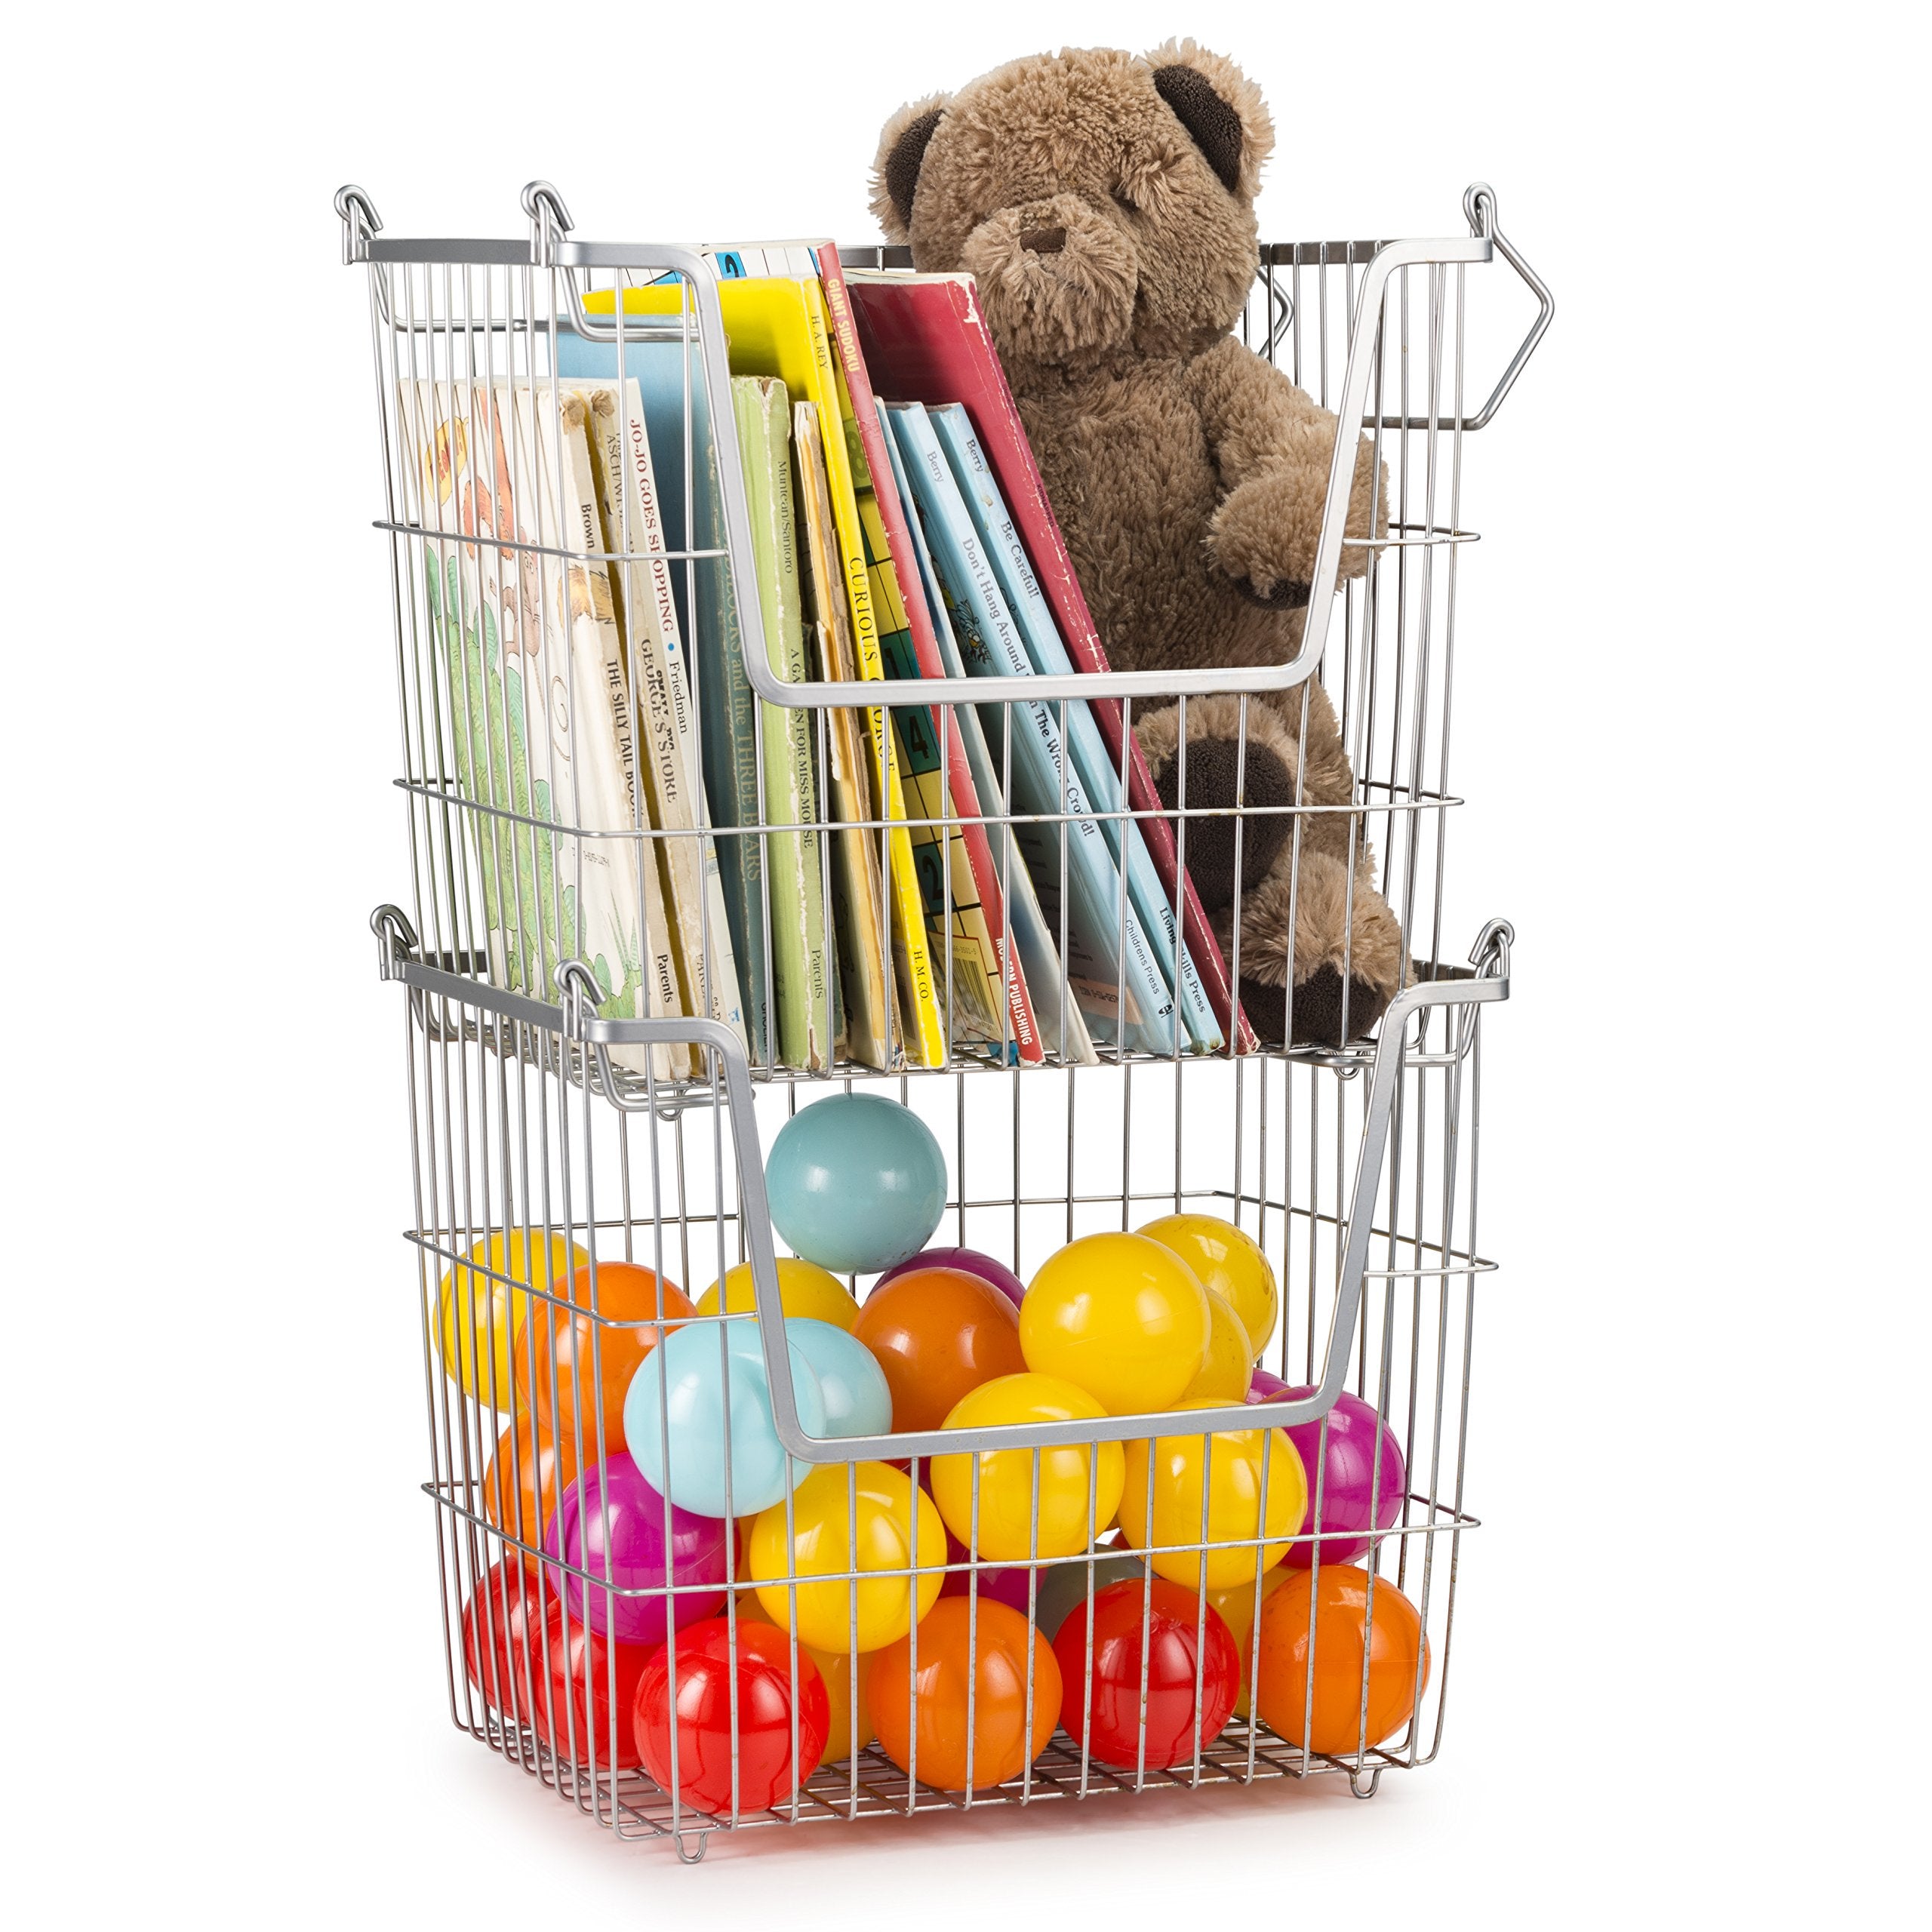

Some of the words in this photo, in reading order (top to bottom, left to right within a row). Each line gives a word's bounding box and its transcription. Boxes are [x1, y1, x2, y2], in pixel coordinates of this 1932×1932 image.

[811, 315, 820, 329] H.
[814, 331, 822, 343] A.
[828, 278, 847, 317] GIANT
[838, 321, 860, 372] SUDOKU
[817, 346, 829, 371] REY
[630, 419, 647, 472] JO-JO
[639, 478, 657, 529] GOES
[927, 451, 944, 482] Berry
[966, 438, 984, 472] Berry
[582, 503, 595, 549] Brown
[778, 460, 793, 574] Muntean/Santoro
[1036, 482, 1055, 528] KIDNAPPED
[1001, 520, 1014, 542] Be
[1011, 544, 1040, 598] Careful!
[962, 537, 986, 579] Don't
[980, 580, 1001, 620] Hang
[996, 621, 1026, 673] Around
[607, 659, 622, 688] THE
[731, 659, 747, 691] and
[791, 648, 800, 659] A
[850, 557, 878, 662] CURIOUS
[869, 677, 895, 771] ORGE
[612, 693, 629, 729] SILLY
[669, 660, 688, 734] Friedman
[734, 695, 748, 726] the
[792, 663, 804, 724] GAEN
[620, 734, 633, 767] TAIL
[795, 727, 806, 757] FOR
[909, 715, 929, 759] 4
[1035, 709, 1050, 737] The
[1046, 738, 1070, 786] Wro
[737, 732, 757, 806] THREE
[798, 760, 809, 795] MISS
[743, 812, 761, 881] BARS
[921, 855, 945, 900] 2
[657, 954, 673, 1003] Parents
[812, 949, 823, 999] Parents
[914, 950, 923, 963] H.
[915, 966, 925, 980] M.
[1125, 919, 1148, 966] Childrens
[1145, 966, 1160, 995] Press
[1159, 906, 1177, 945] Living
[1189, 980, 1206, 1013] Press
[918, 982, 929, 1002] CO.
[1009, 984, 1033, 1045] PUBLISHING
